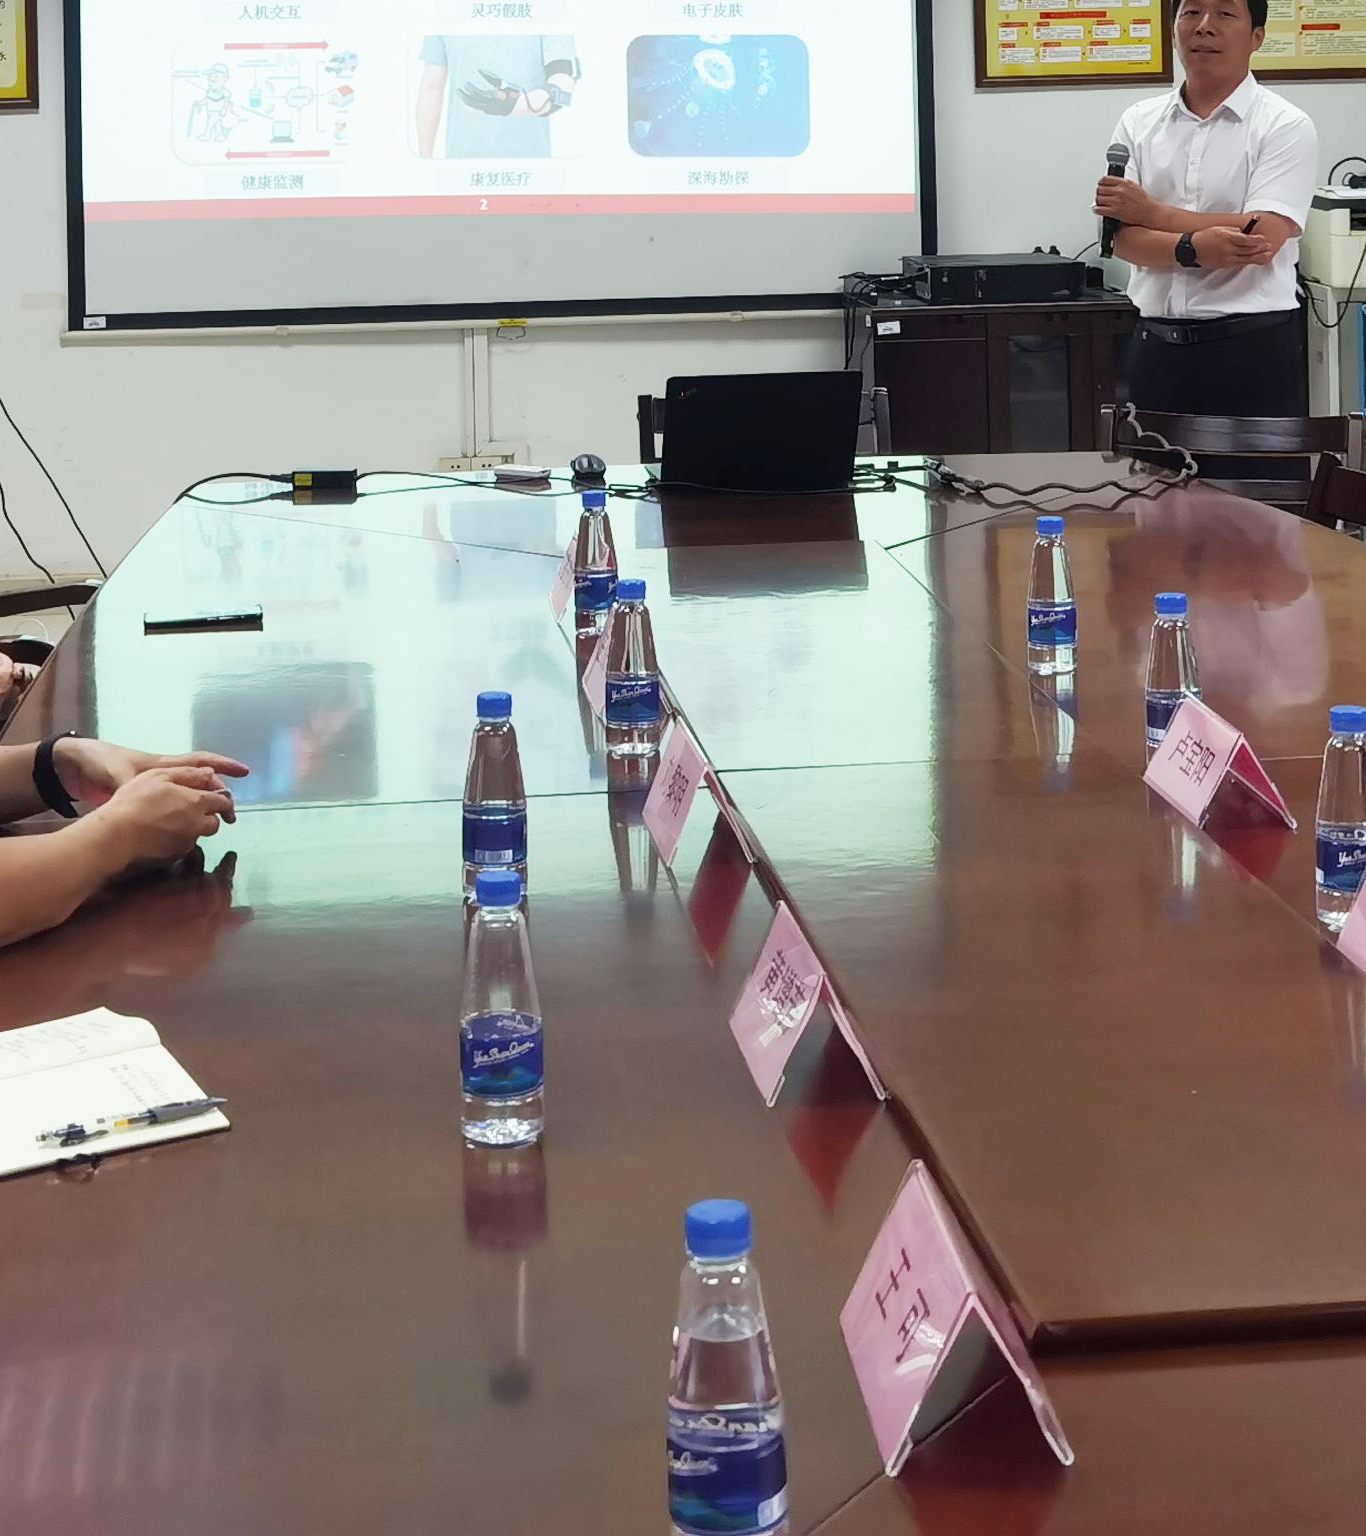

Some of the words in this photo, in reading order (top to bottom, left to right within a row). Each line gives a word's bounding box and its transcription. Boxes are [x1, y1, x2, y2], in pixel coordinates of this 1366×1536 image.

[238, 4, 301, 20] 人机交互
[471, 3, 533, 18] 灵巧假肢
[682, 3, 744, 18] 电子皮肤
[241, 174, 304, 191] 健康监测
[470, 171, 531, 187] 康复医疗
[688, 171, 749, 186] 深海勘探
[478, 199, 488, 211] 2
[1168, 730, 1216, 786] 卢宝阳
